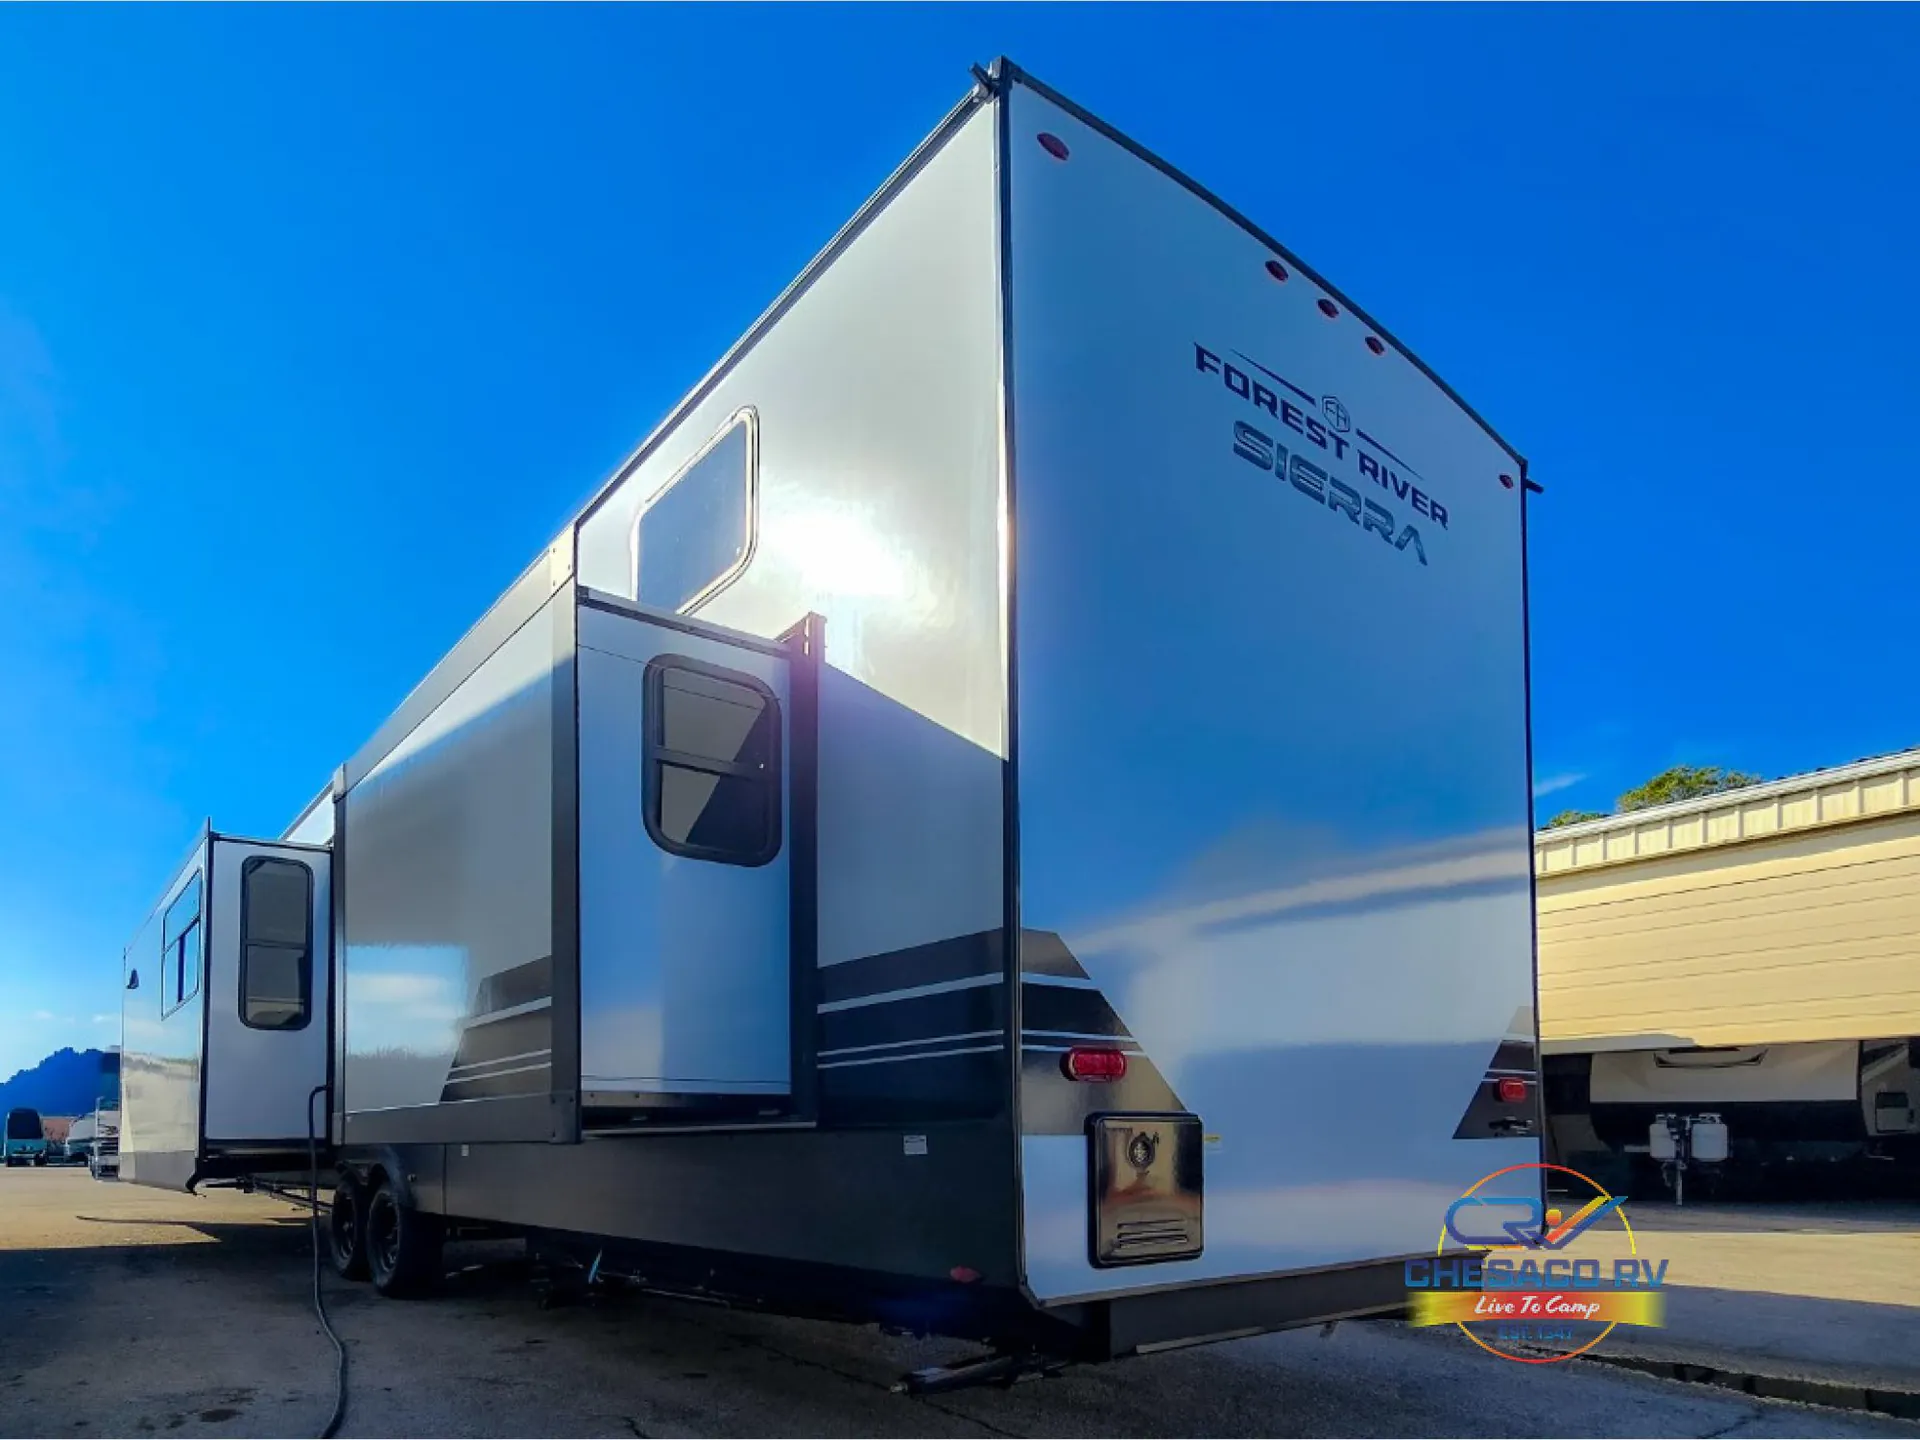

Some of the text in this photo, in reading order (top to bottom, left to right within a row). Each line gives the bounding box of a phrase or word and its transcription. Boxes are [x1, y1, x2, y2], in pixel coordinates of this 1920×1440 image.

[1194, 342, 1448, 530] FOREST RIVER
[1233, 420, 1428, 566] SIERRA
